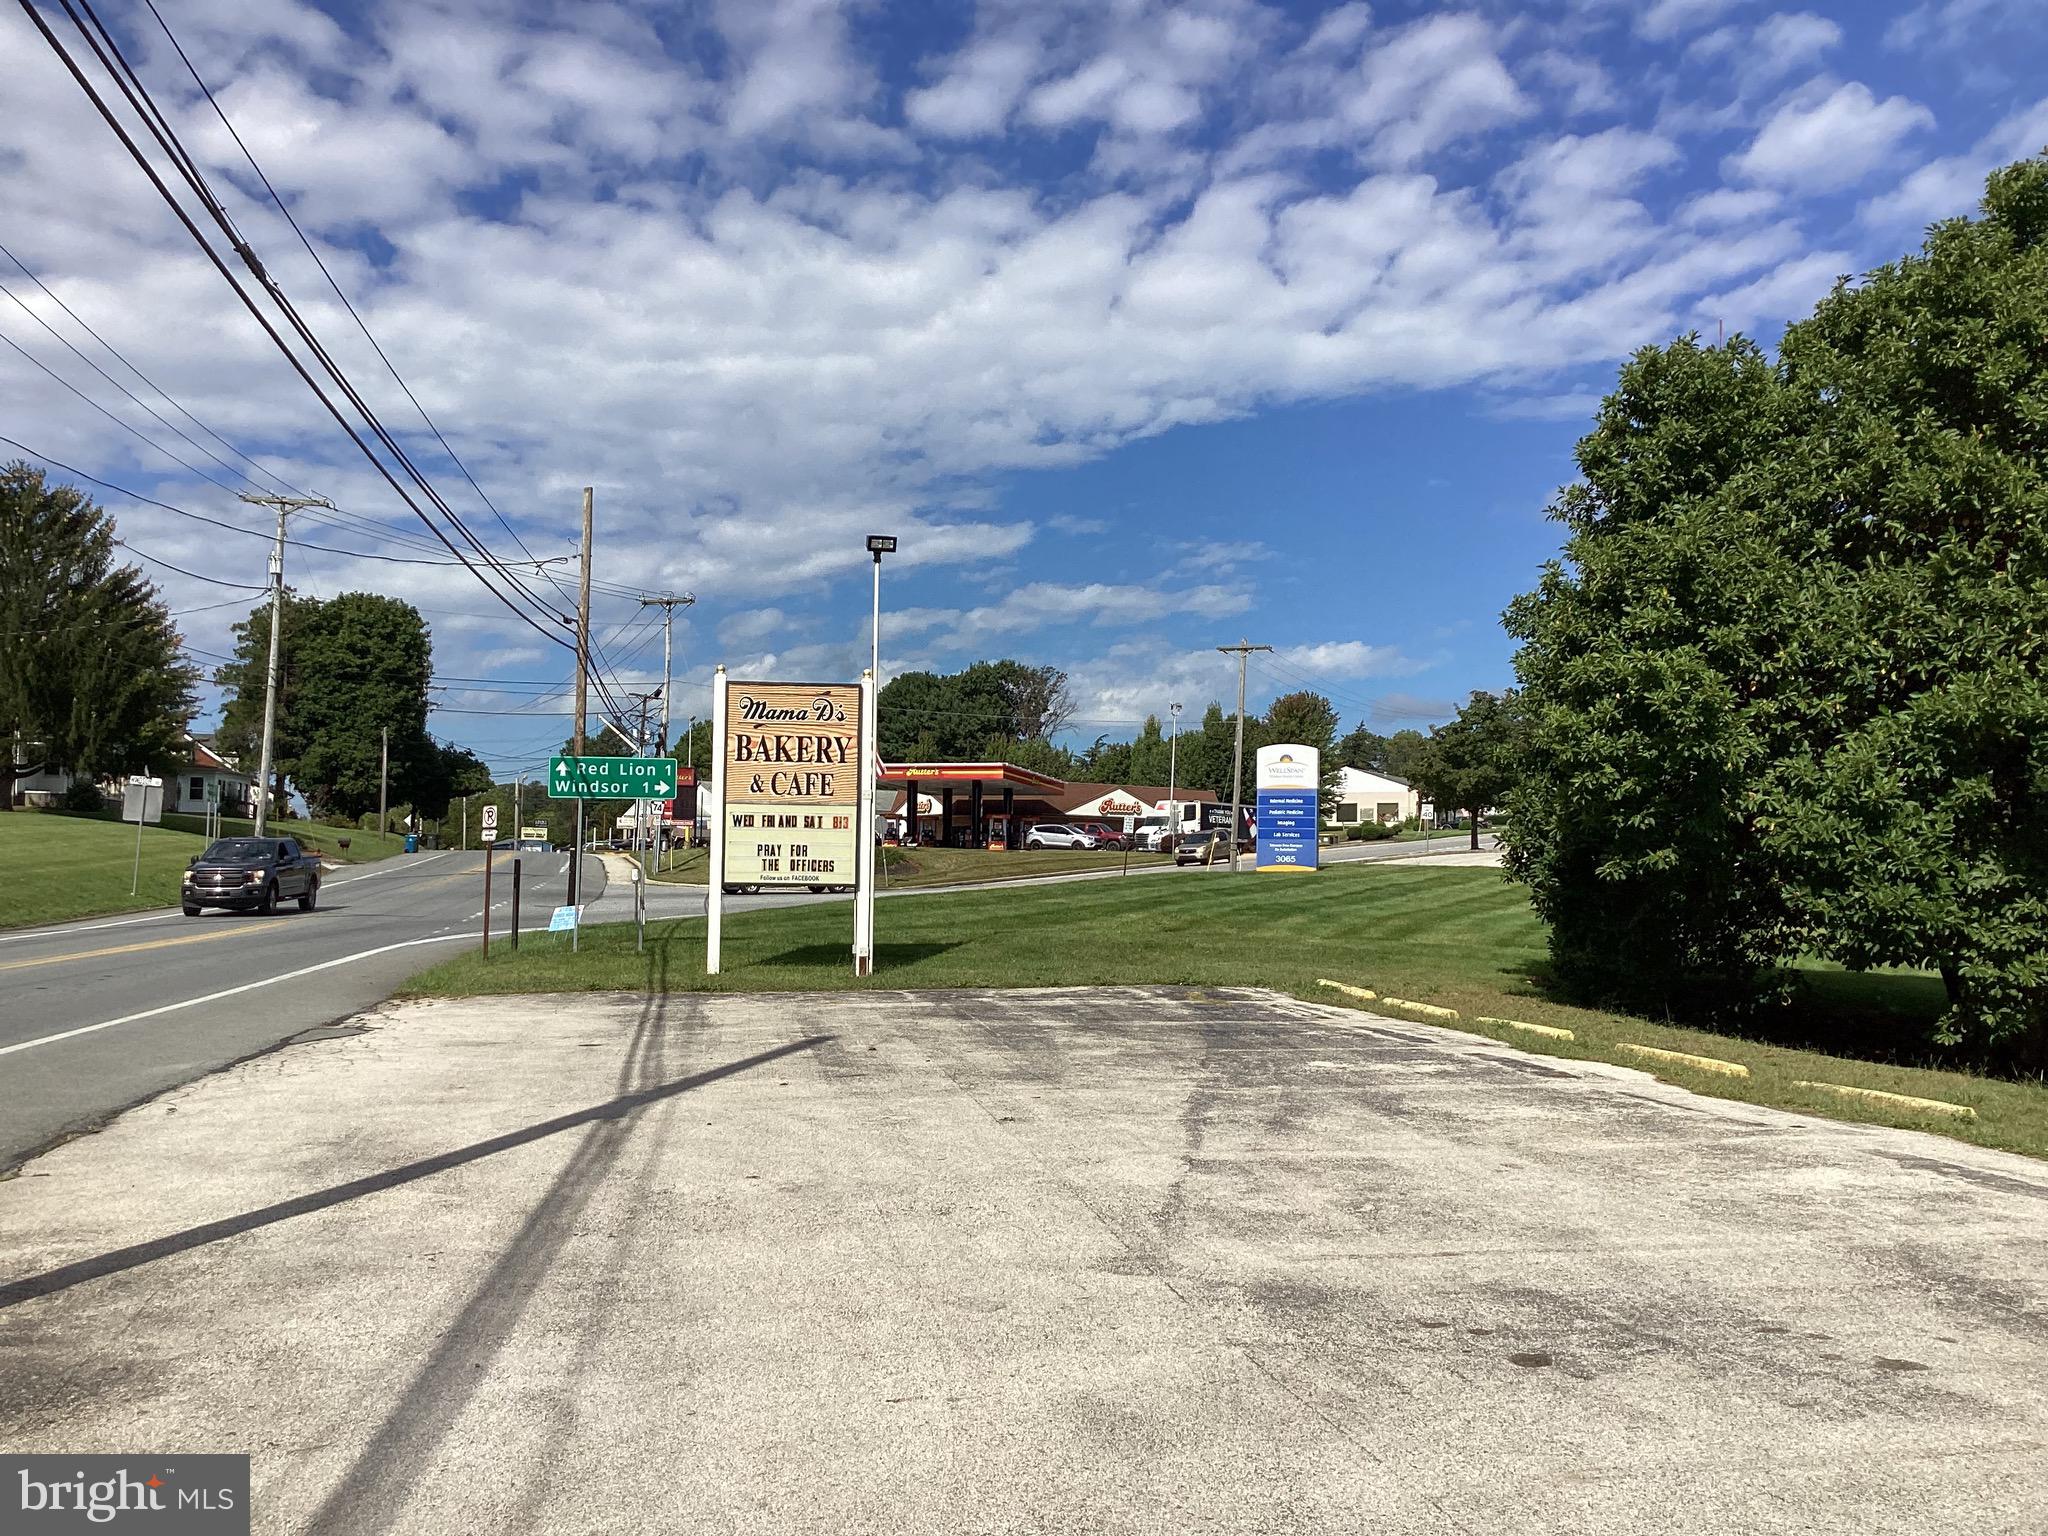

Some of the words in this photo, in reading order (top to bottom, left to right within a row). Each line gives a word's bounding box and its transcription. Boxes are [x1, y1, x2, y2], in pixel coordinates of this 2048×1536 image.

[739, 696, 809, 720] Mama
[812, 697, 847, 721] D's
[734, 734, 853, 763] BAKERY
[576, 763, 608, 775] Red
[620, 763, 656, 776] Lion
[664, 765, 671, 776] 1
[555, 780, 628, 793] Windsor
[642, 781, 649, 793] 1
[750, 774, 764, 793] &
[771, 772, 834, 796] CAFE
[1100, 799, 1142, 815] Rutter's
[732, 815, 754, 827] WED
[762, 815, 775, 827] FRI
[778, 815, 797, 828] AND
[804, 816, 823, 829] SAT
[1209, 815, 1233, 824] VETERAN
[757, 844, 781, 857] PRAY
[790, 845, 808, 857] FOR
[762, 859, 779, 871] THE
[790, 860, 835, 872] OFFICERS
[1275, 855, 1296, 863] 3065
